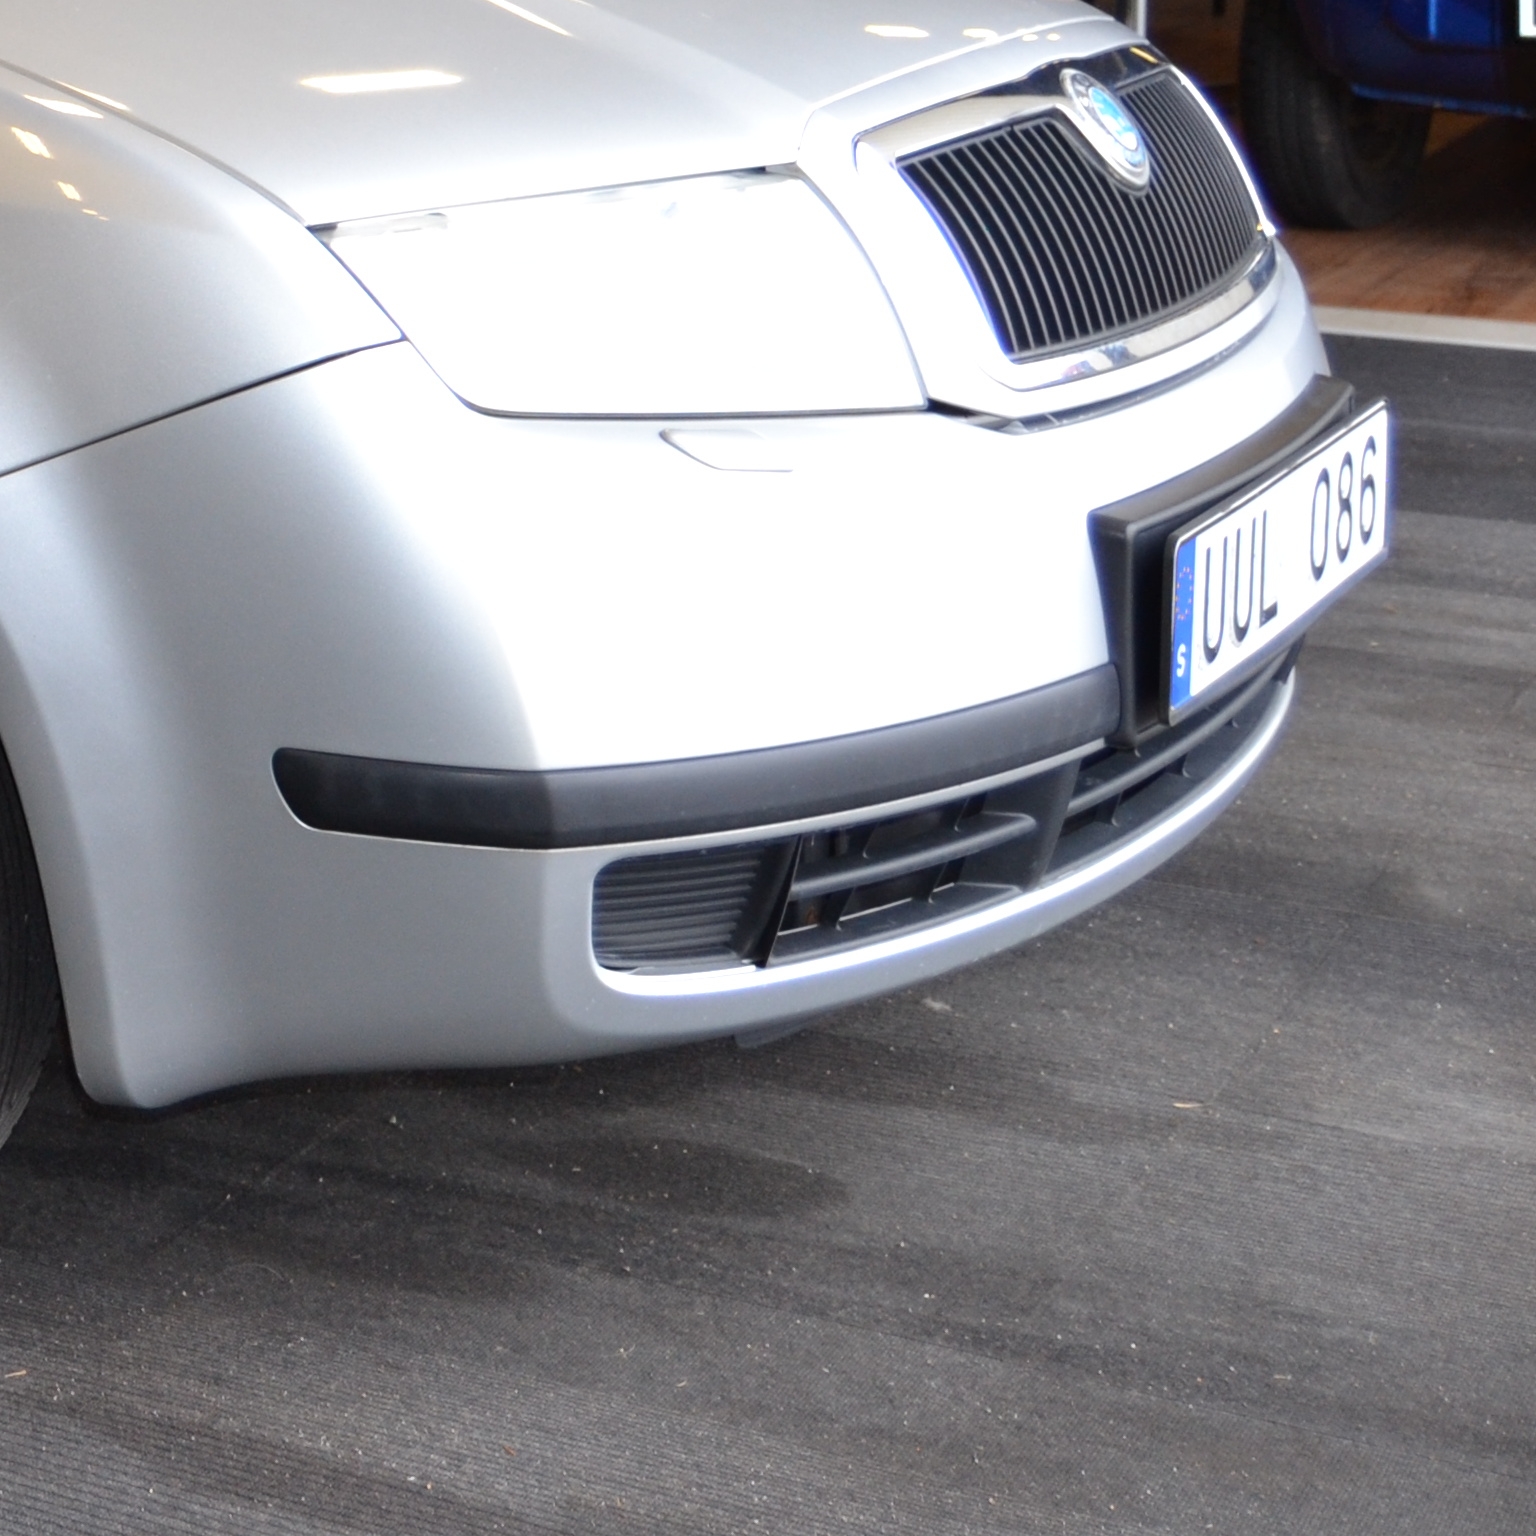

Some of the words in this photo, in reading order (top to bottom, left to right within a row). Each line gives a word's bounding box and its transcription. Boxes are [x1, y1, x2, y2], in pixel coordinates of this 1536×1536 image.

[1203, 509, 1278, 665] UUL
[1310, 435, 1377, 582] 086
[1176, 642, 1186, 678] S
